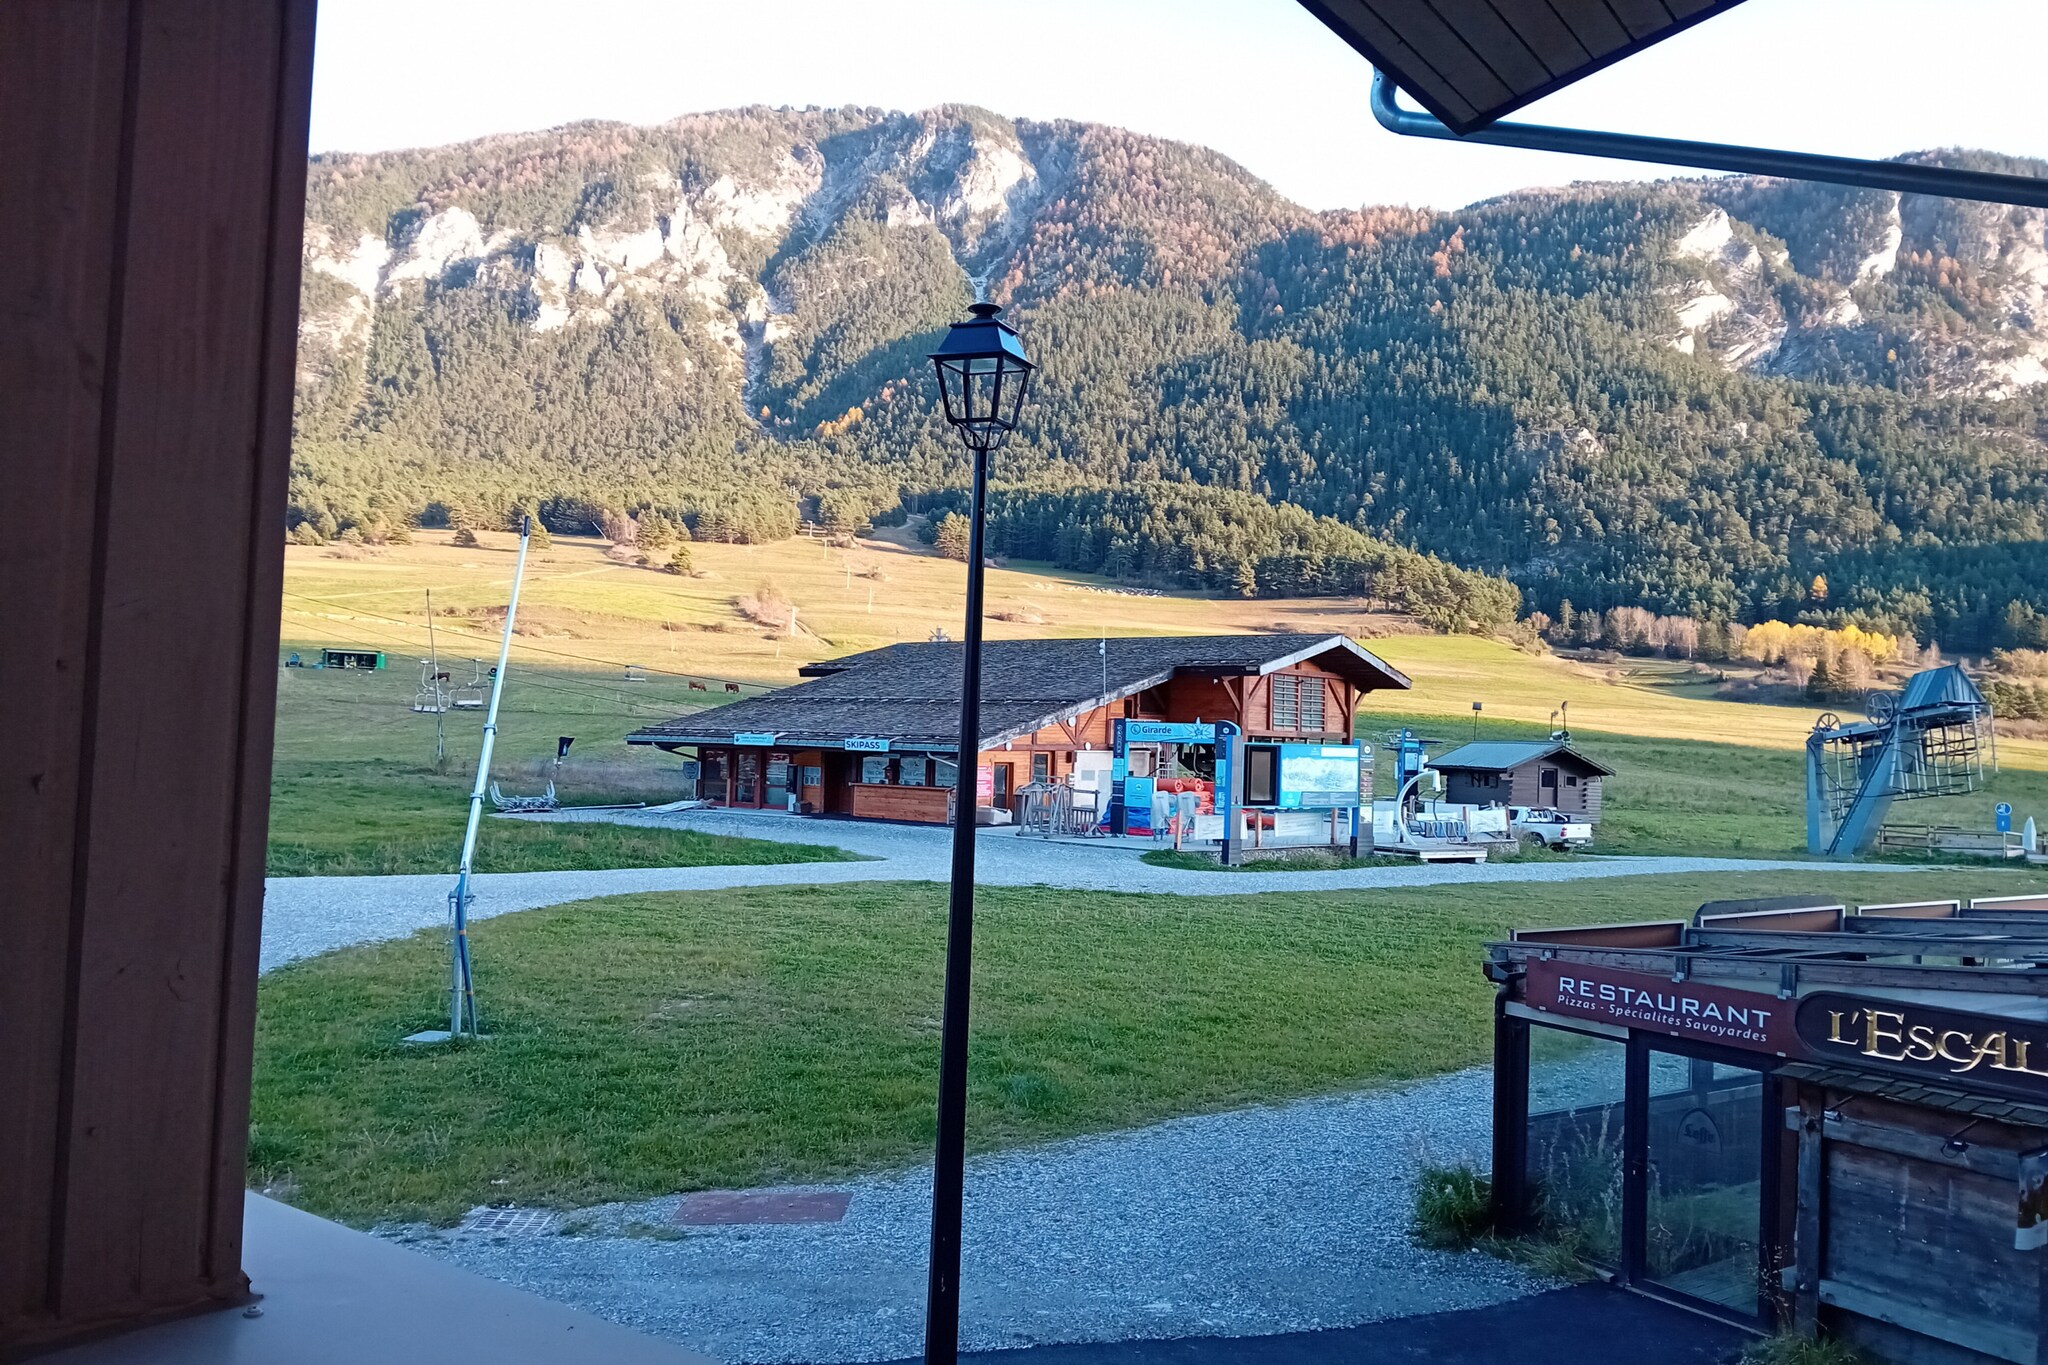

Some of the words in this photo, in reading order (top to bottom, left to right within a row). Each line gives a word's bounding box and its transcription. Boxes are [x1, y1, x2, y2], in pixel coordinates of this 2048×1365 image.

[846, 740, 880, 750] SKIPASS
[1142, 725, 1172, 734] Girarde
[1557, 994, 1596, 1011] Pizzas
[1608, 1003, 1681, 1026] Spécialités
[1685, 1018, 1768, 1042] Savoyardes
[1558, 976, 1771, 1028] RESTAURANT
[1827, 1007, 2048, 1077] L'ESCAL
